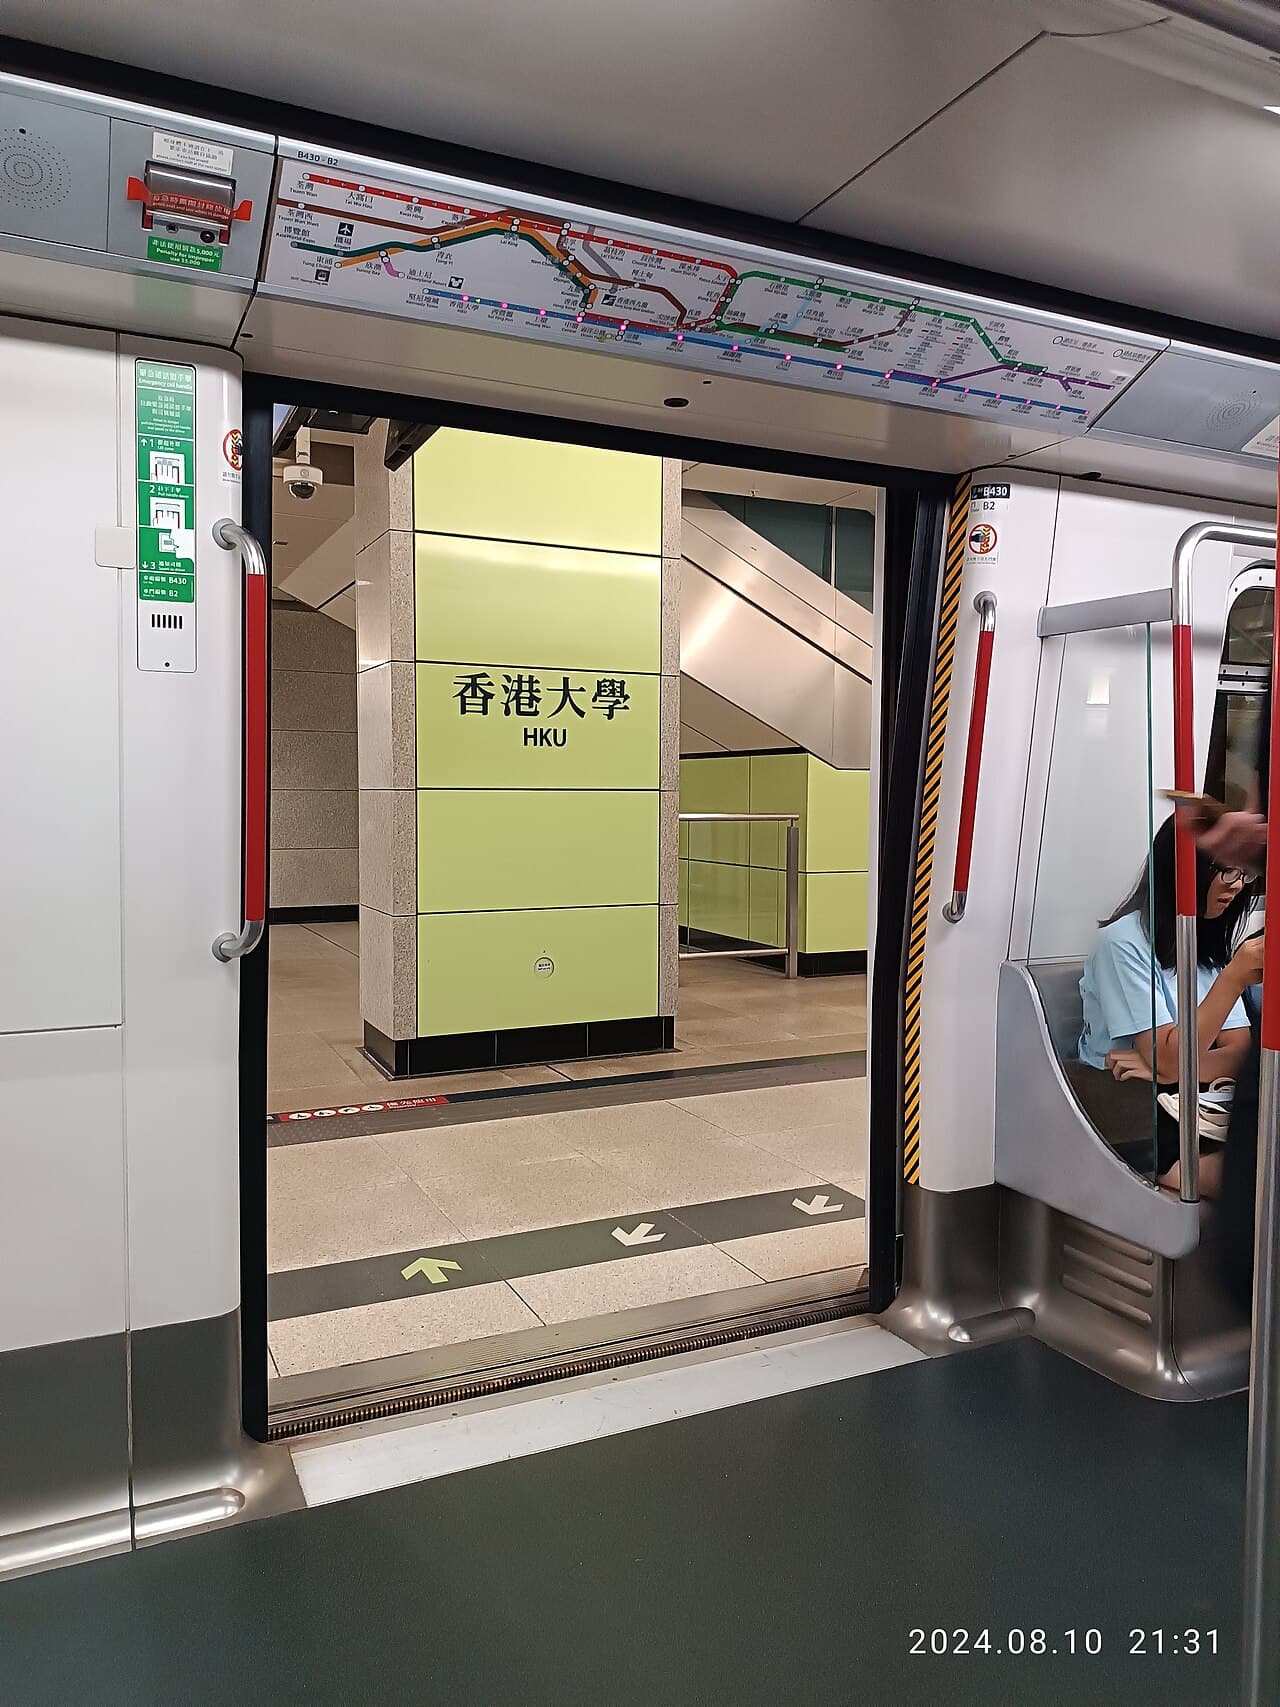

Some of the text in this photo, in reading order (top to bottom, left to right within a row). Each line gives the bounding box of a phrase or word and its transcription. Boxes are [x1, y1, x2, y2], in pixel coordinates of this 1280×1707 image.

[297, 150, 320, 162] B430
[327, 157, 339, 166] B2
[156, 247, 178, 258] Penalty
[138, 377, 166, 388] Emergency
[150, 439, 154, 447] 1
[149, 485, 155, 494] 2
[983, 486, 1008, 497] B430
[983, 501, 996, 511] B2
[150, 561, 156, 570] 3
[168, 576, 187, 585] B430
[168, 589, 178, 598] B2
[452, 672, 631, 721] 香港大學
[523, 727, 567, 748] HKU
